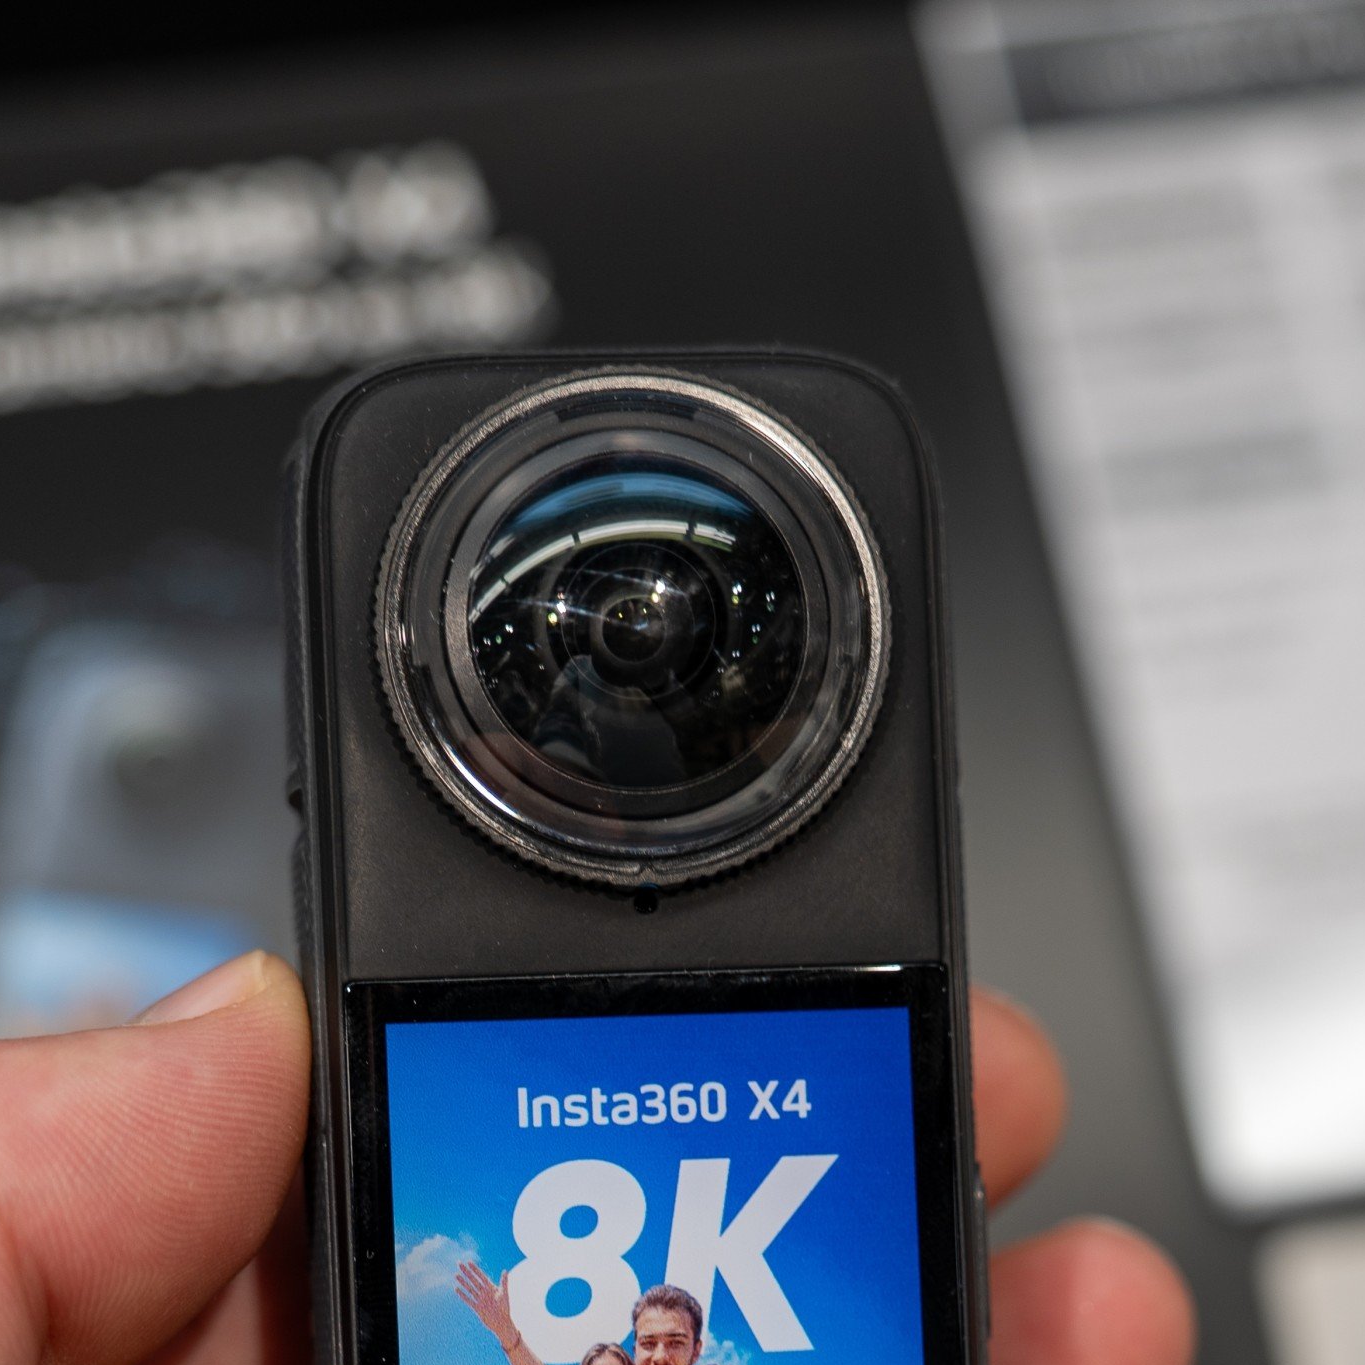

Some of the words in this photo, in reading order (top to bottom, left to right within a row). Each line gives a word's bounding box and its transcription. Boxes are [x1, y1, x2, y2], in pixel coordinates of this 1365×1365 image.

[517, 1081, 728, 1129] Insta360
[747, 1079, 813, 1121] X4
[508, 1153, 840, 1365] 8K
